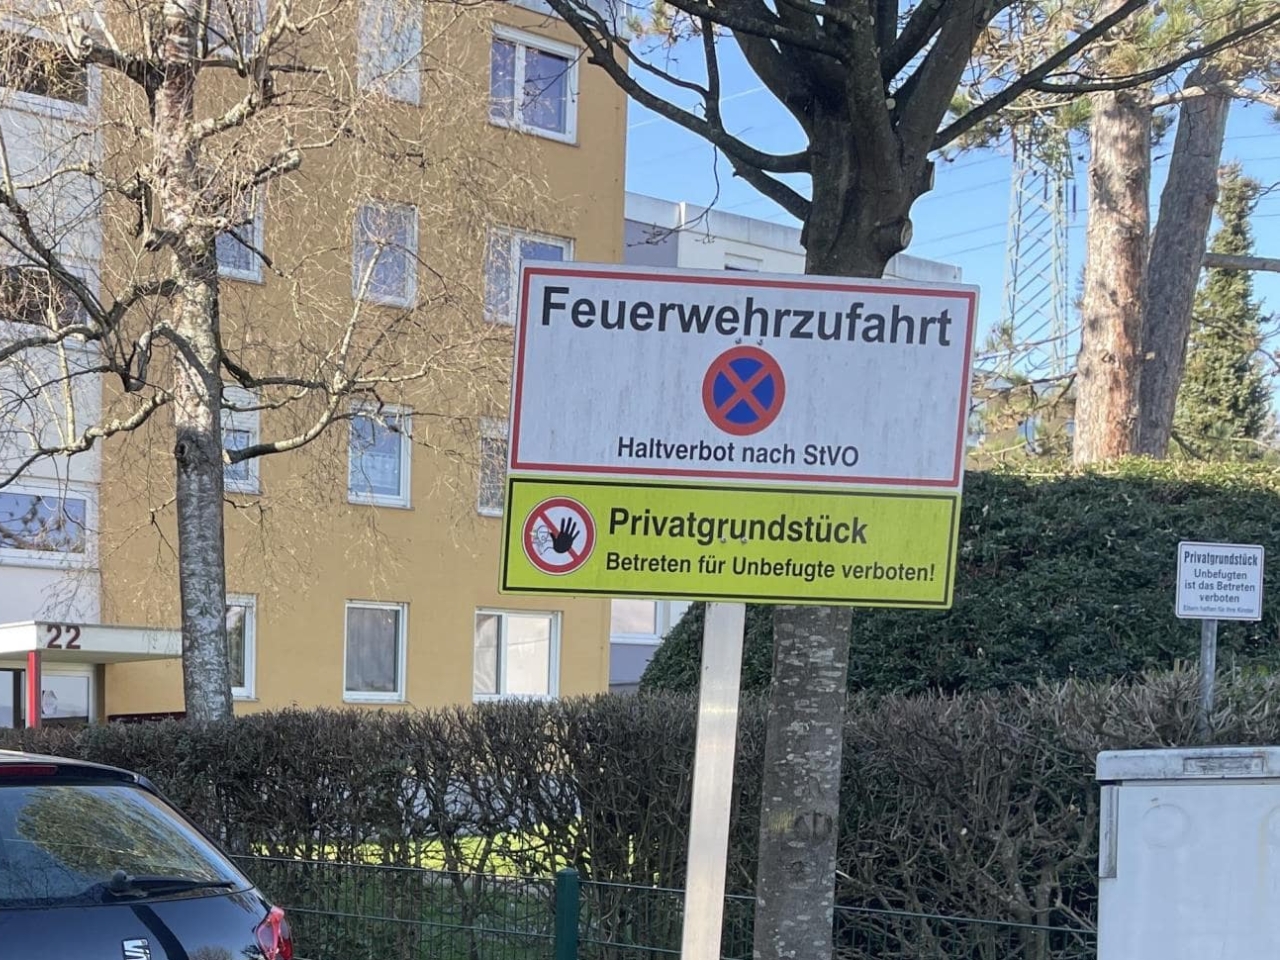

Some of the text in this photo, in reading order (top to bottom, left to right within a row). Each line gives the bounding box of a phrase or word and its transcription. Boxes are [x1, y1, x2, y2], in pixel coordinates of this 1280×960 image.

[541, 285, 952, 347] Feuerwehrzufahrt
[617, 436, 860, 468] Haltverbot nach StVO
[608, 507, 869, 545] Privatgrundstück
[605, 552, 935, 582] Betreten für Unbefugte verboten!
[1184, 551, 1257, 566] Privatgrundstück
[1184, 580, 1255, 592] ist das Betreten
[1194, 569, 1247, 581] Unbefugten
[1199, 592, 1240, 603] verboten
[47, 625, 81, 649] 22
